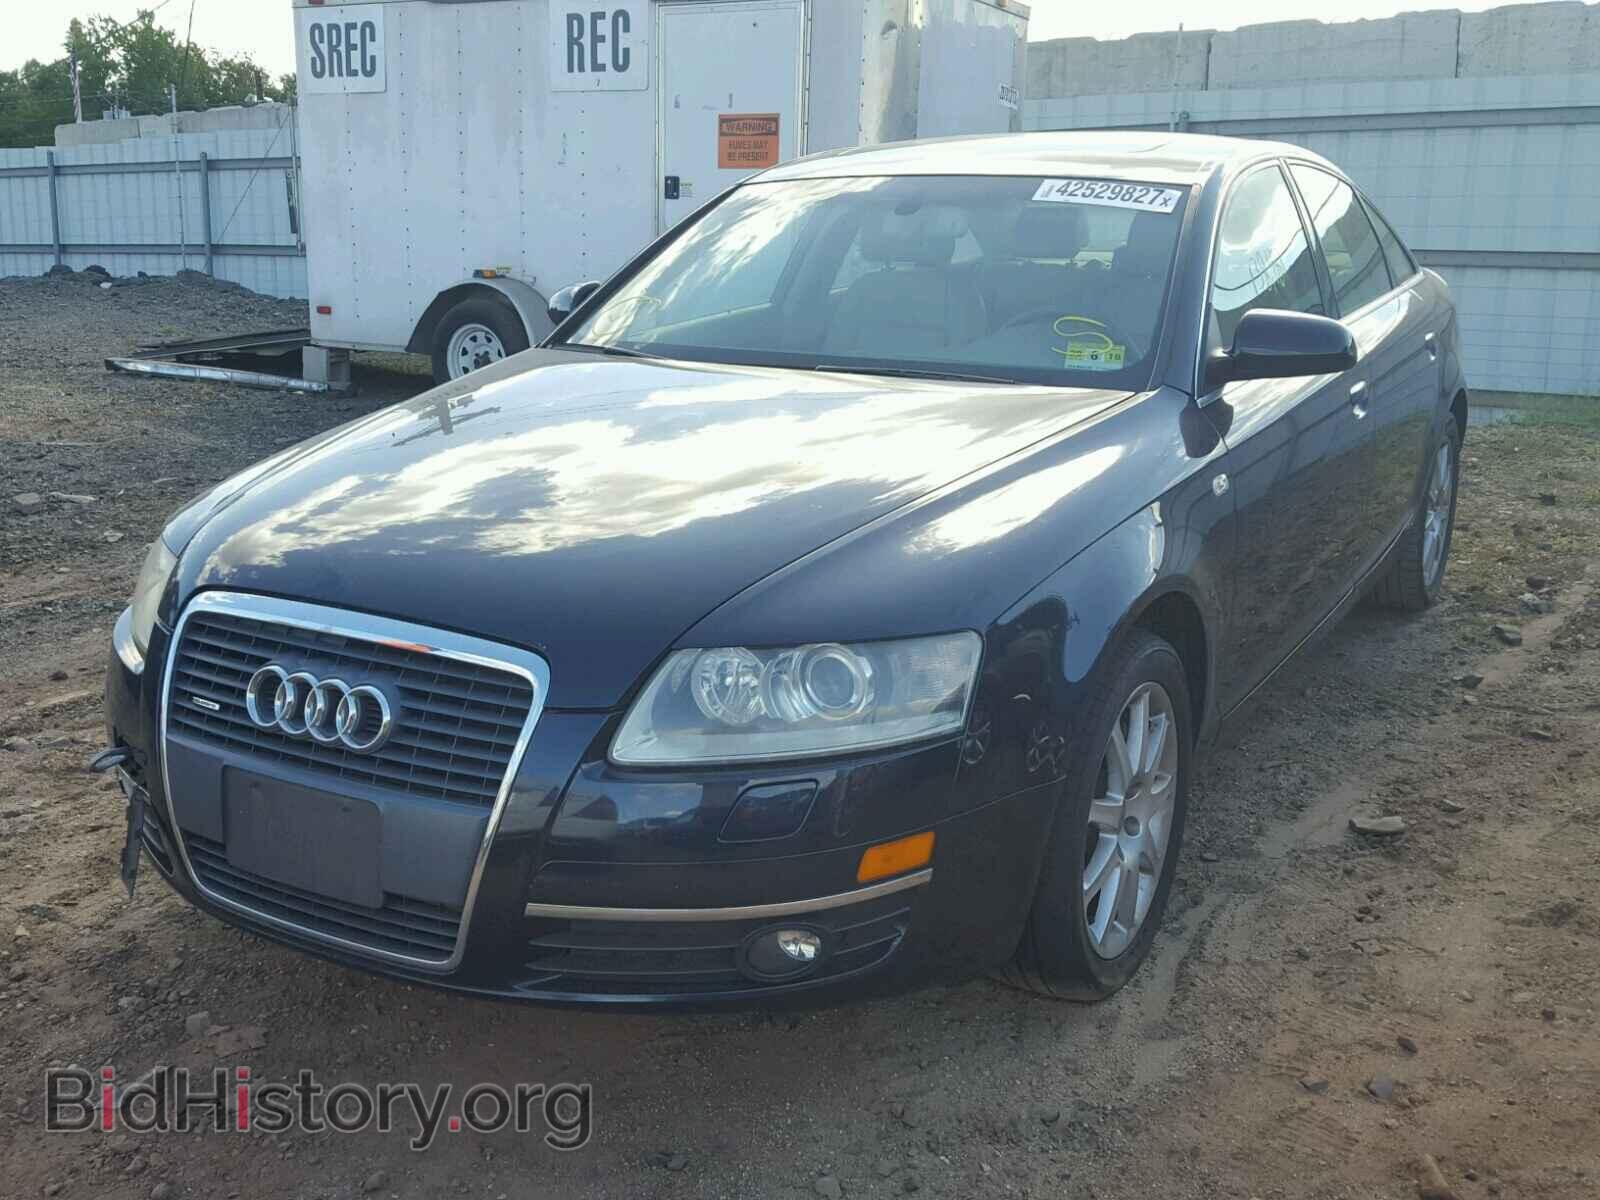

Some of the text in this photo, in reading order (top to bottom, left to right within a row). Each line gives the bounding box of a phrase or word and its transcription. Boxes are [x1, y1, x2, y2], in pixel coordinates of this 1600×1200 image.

[309, 20, 376, 79] SREC
[566, 9, 630, 73] REC
[725, 120, 772, 133] WARNING
[737, 151, 768, 160] PRESENT
